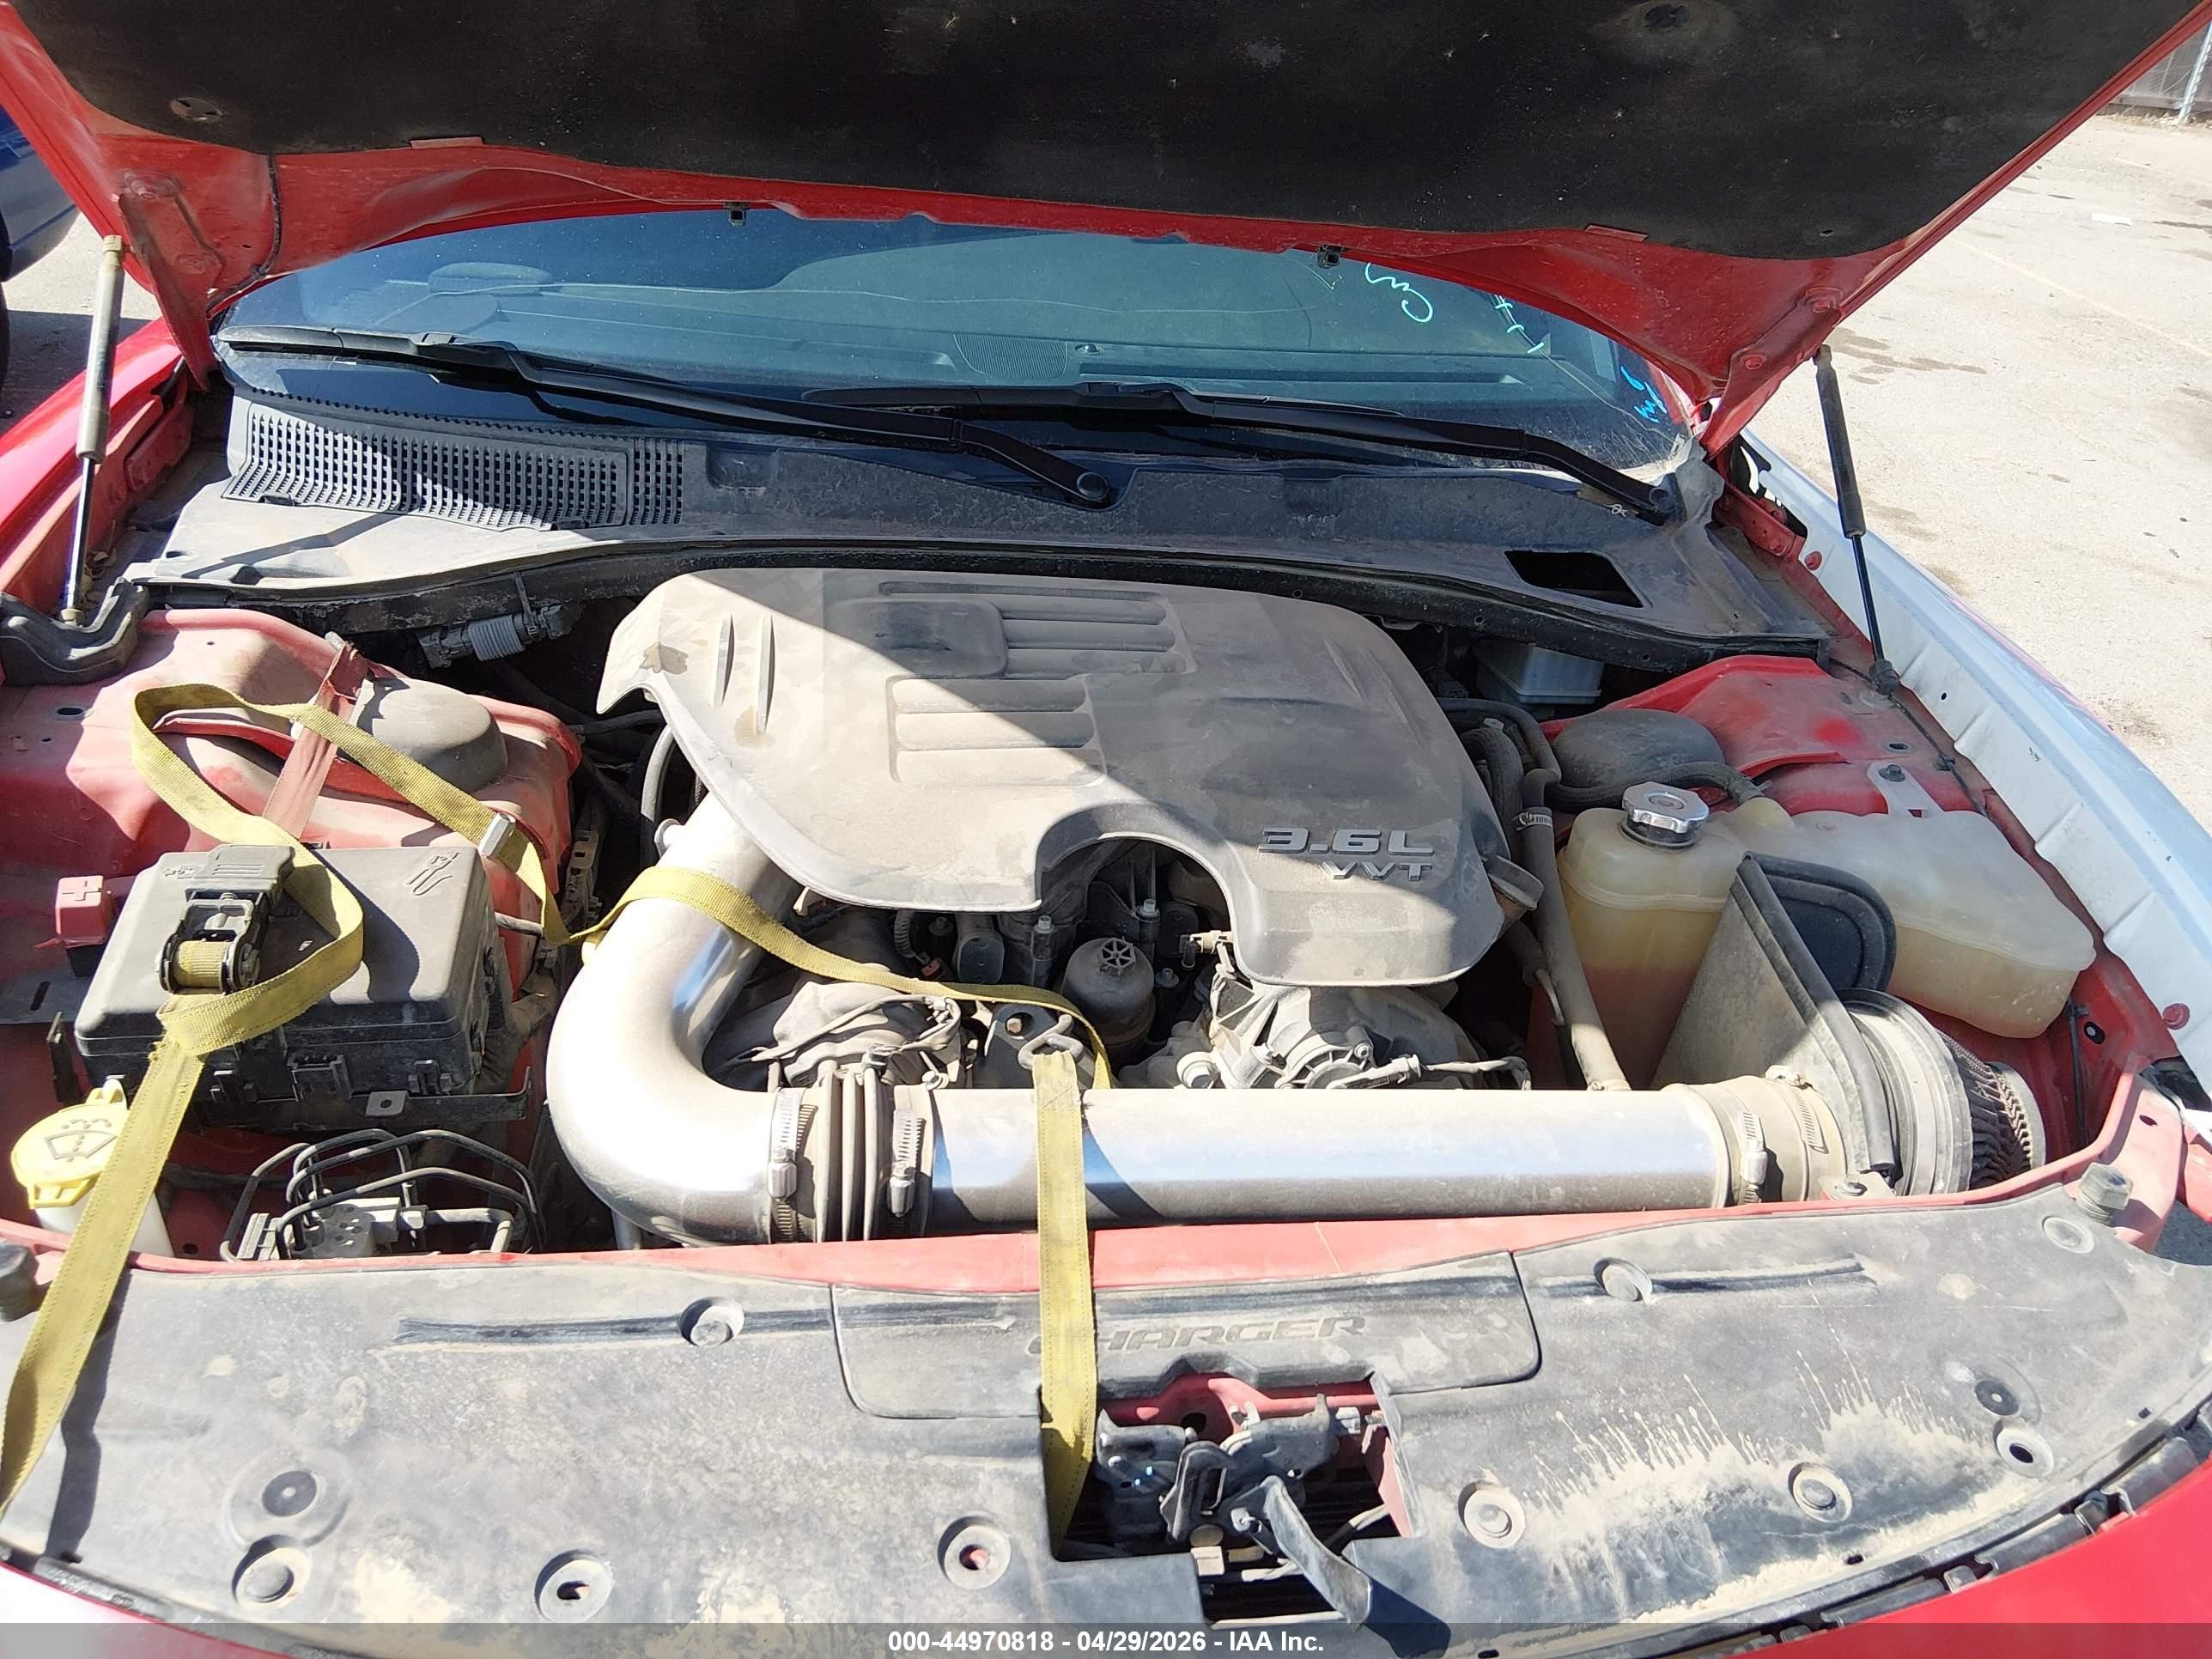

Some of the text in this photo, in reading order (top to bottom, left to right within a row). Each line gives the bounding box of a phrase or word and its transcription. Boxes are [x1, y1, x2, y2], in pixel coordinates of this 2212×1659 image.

[1256, 827, 1435, 856] 3.6L
[1322, 860, 1433, 882] VVT
[1028, 1316, 1366, 1354] HARGER
